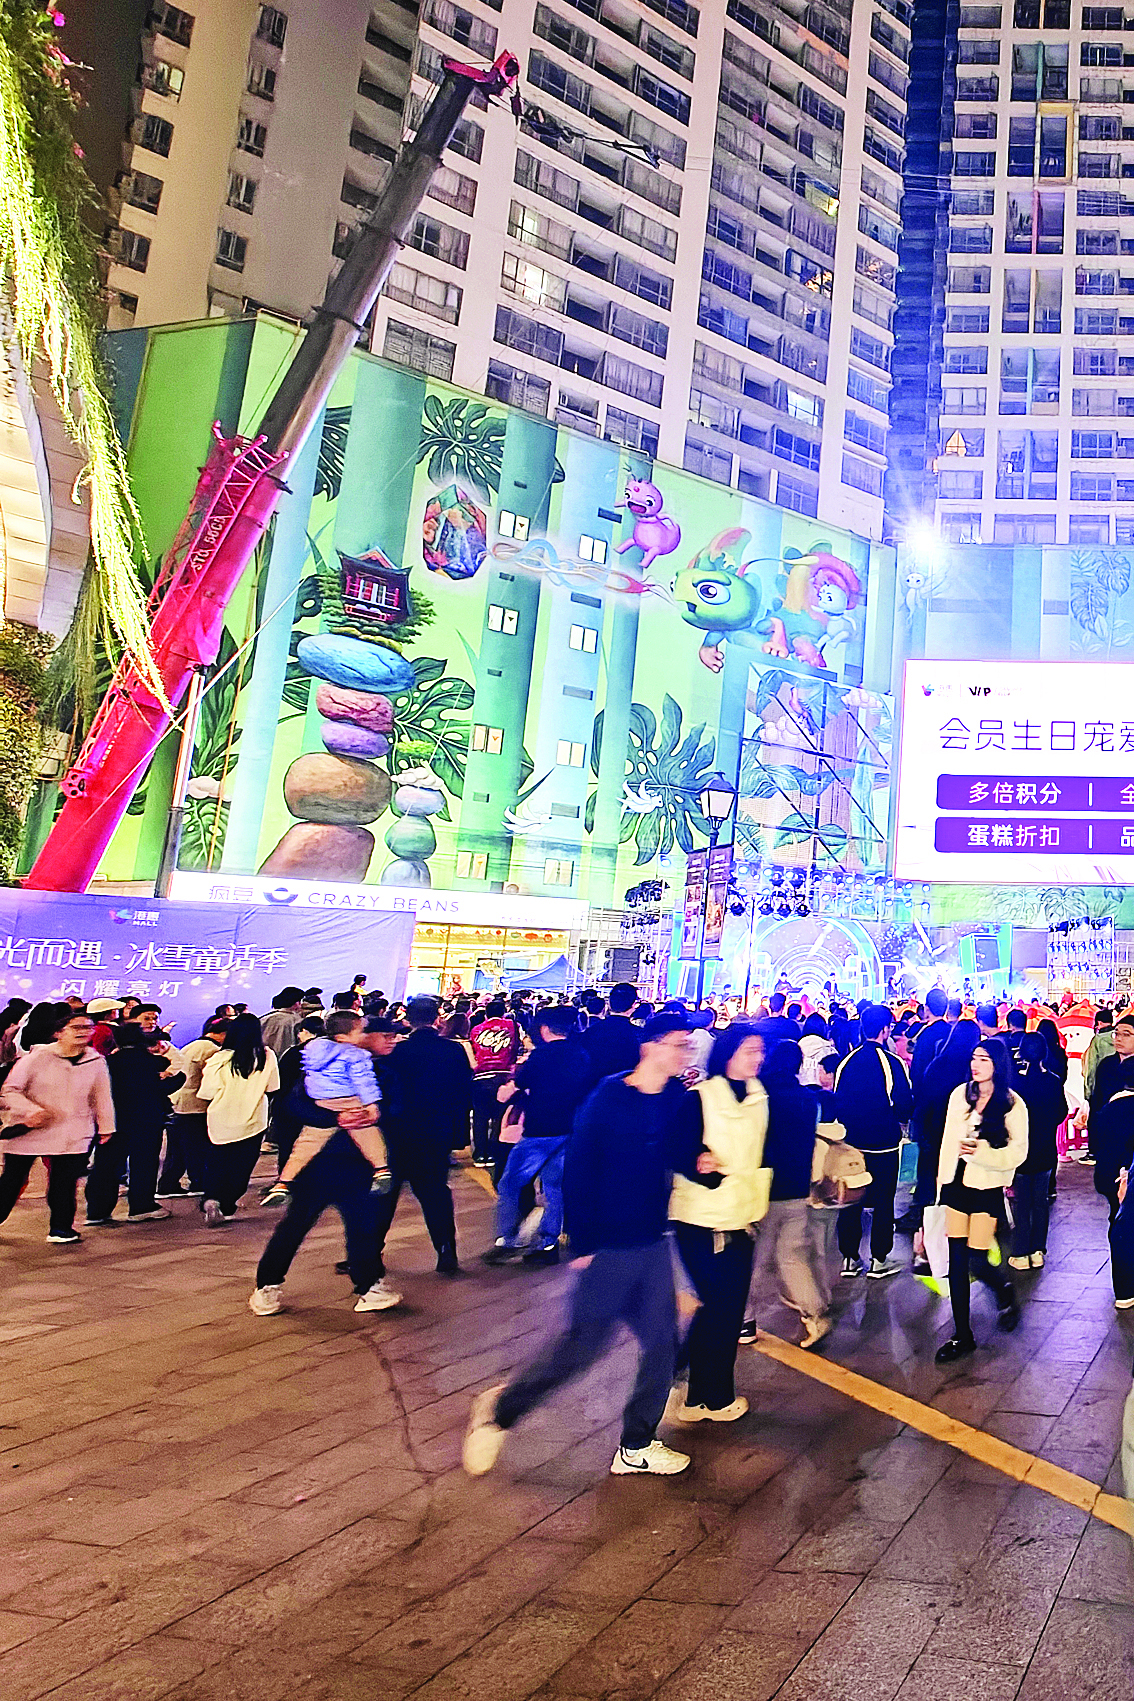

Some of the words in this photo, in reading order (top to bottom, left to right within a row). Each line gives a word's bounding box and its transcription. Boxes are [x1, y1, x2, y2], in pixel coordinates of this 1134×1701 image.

[968, 781, 1062, 805] 多倍积分
[967, 823, 1060, 847] 蛋糕折扣
[208, 885, 254, 902] 疯豆
[307, 892, 380, 907] CRAZY
[393, 897, 460, 912] BEANS
[60, 978, 184, 998] 闪耀亮灯
